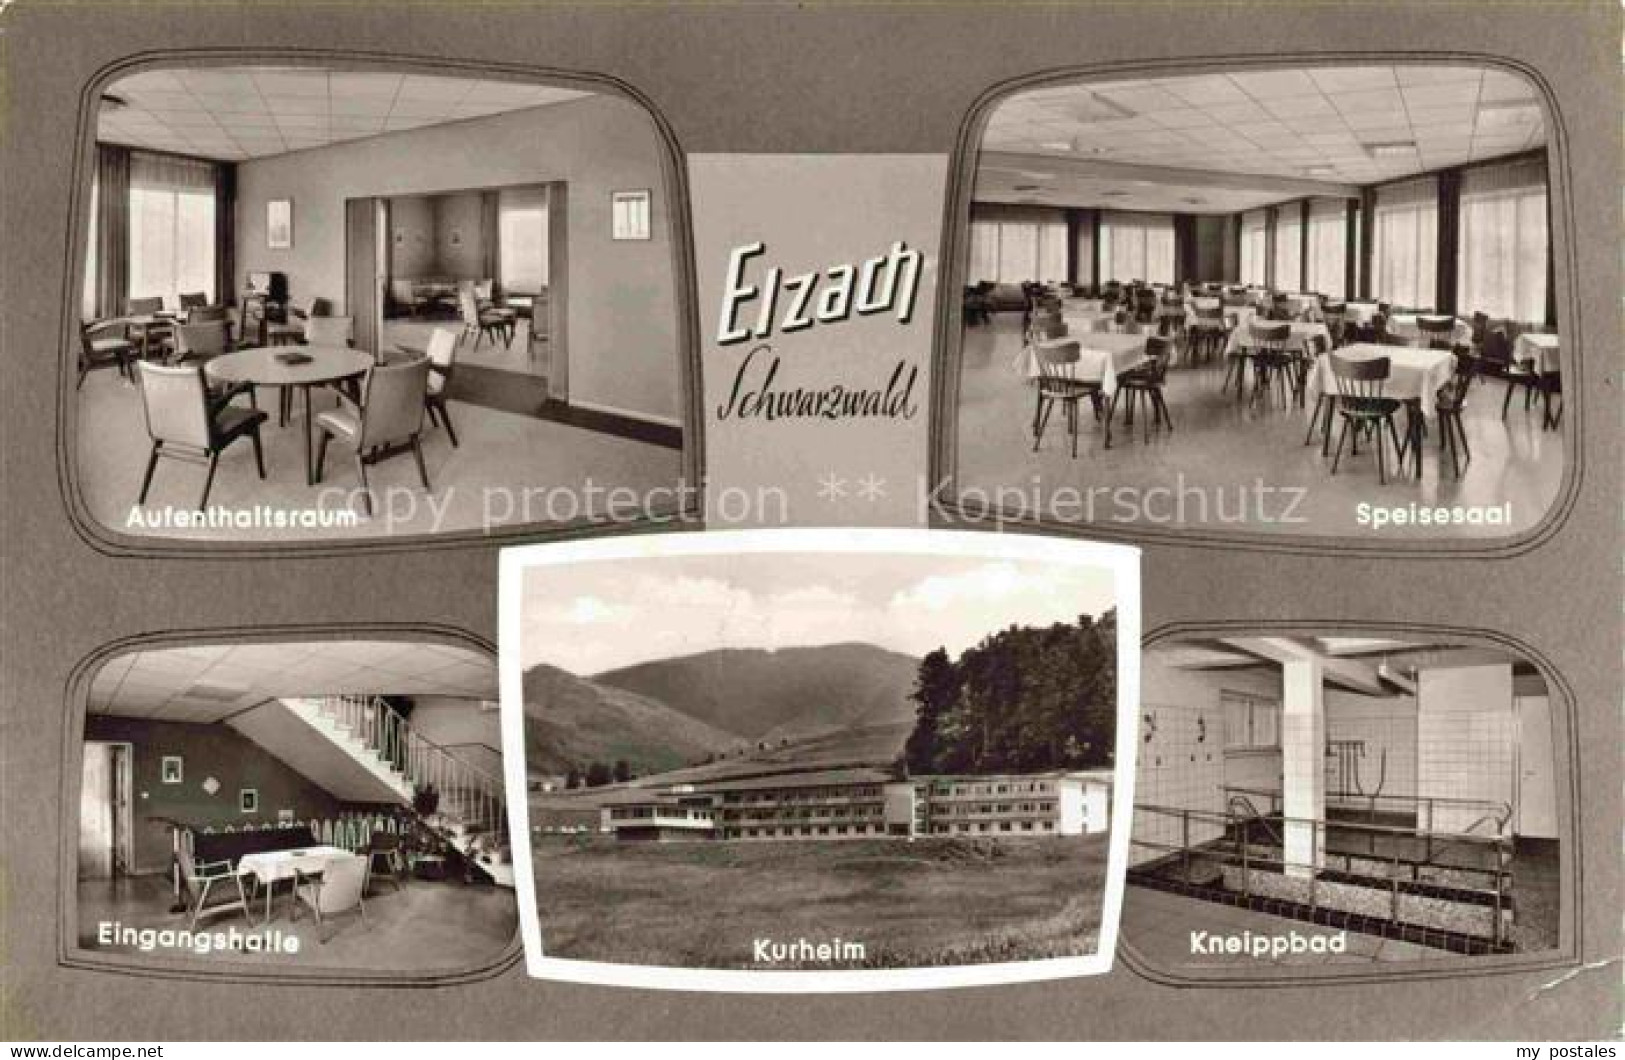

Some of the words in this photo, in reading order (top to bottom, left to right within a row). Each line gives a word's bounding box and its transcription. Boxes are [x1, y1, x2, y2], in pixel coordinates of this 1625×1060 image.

[717, 241, 924, 346] Elzach
[716, 344, 918, 421] Schwarzwald
[126, 505, 358, 529] Aufenthaltsraum
[1356, 501, 1513, 530] Speisesaal
[98, 920, 300, 955] Eingangshalle
[753, 937, 866, 962] Kurheim
[1190, 930, 1347, 959] Kneippbad
